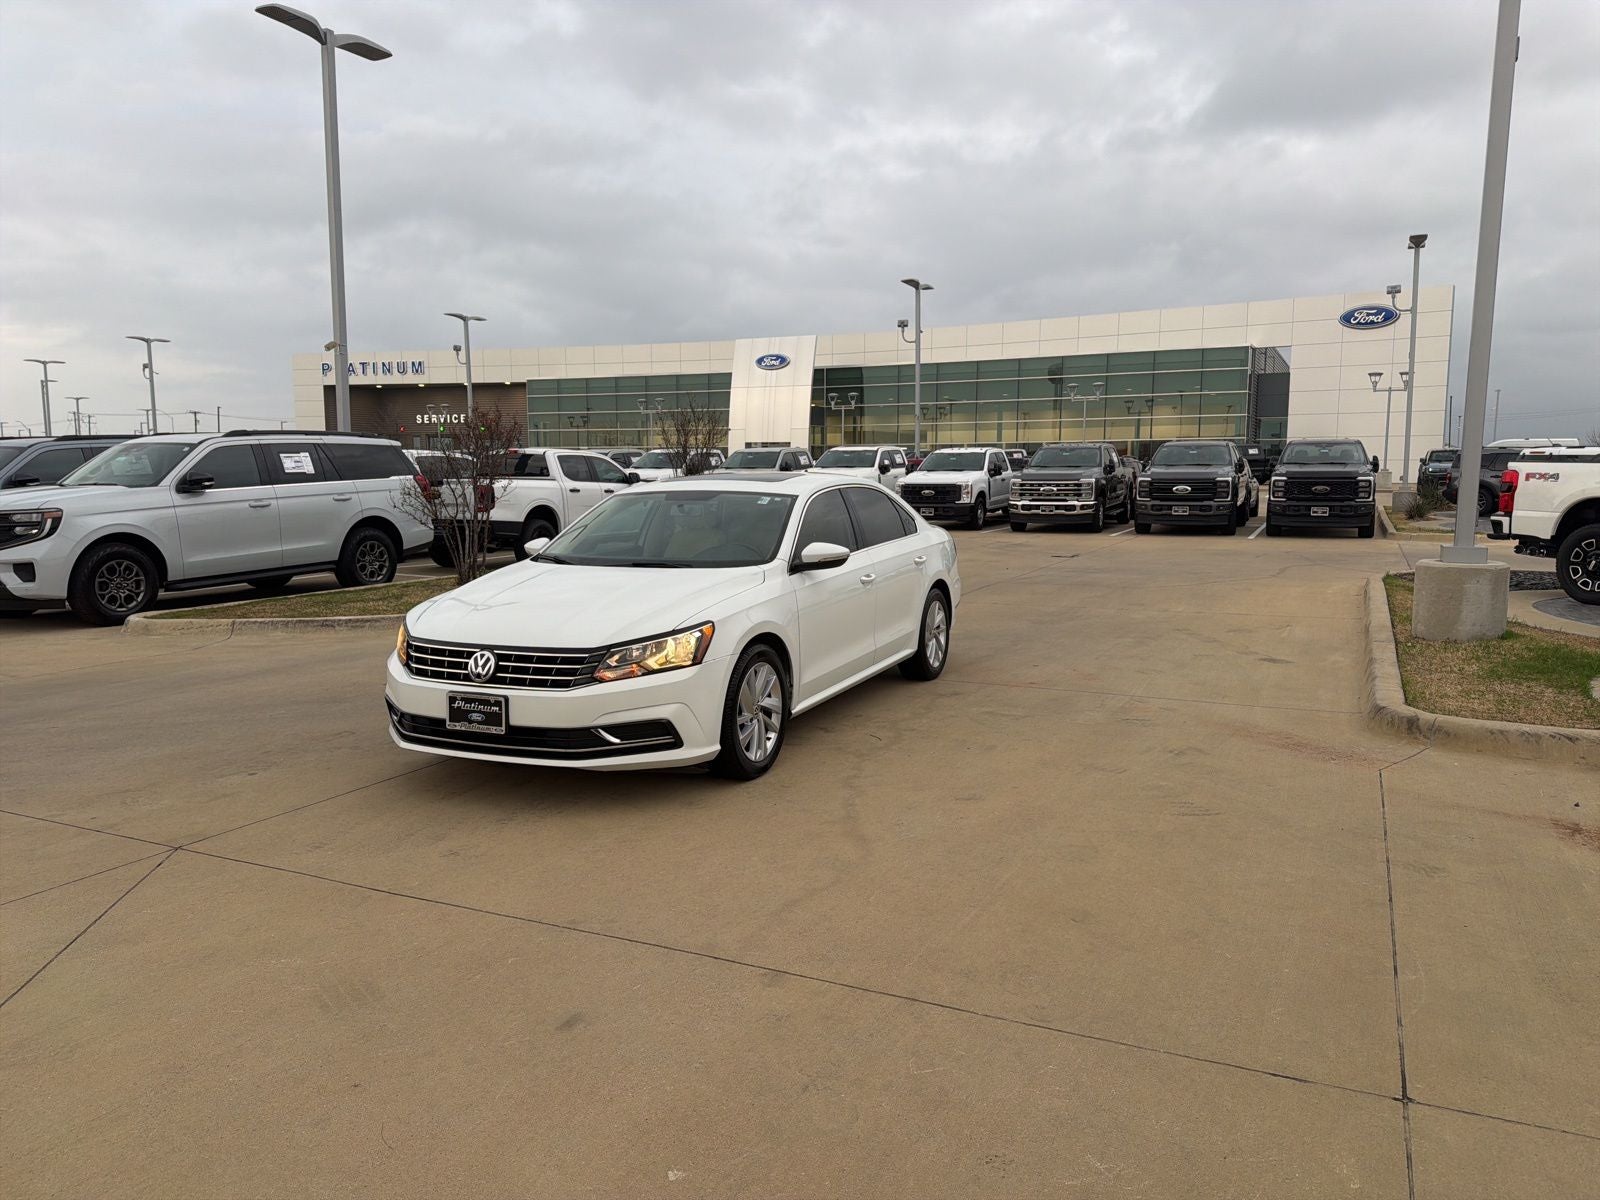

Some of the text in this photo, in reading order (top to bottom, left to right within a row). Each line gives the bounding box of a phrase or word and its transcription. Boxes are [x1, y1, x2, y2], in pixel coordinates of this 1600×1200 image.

[1351, 309, 1385, 324] Ford
[761, 356, 781, 366] Ford
[321, 360, 425, 376] PATINUM
[416, 414, 466, 424] SERVICE
[1525, 472, 1560, 482] FX4
[451, 700, 502, 713] Platinum
